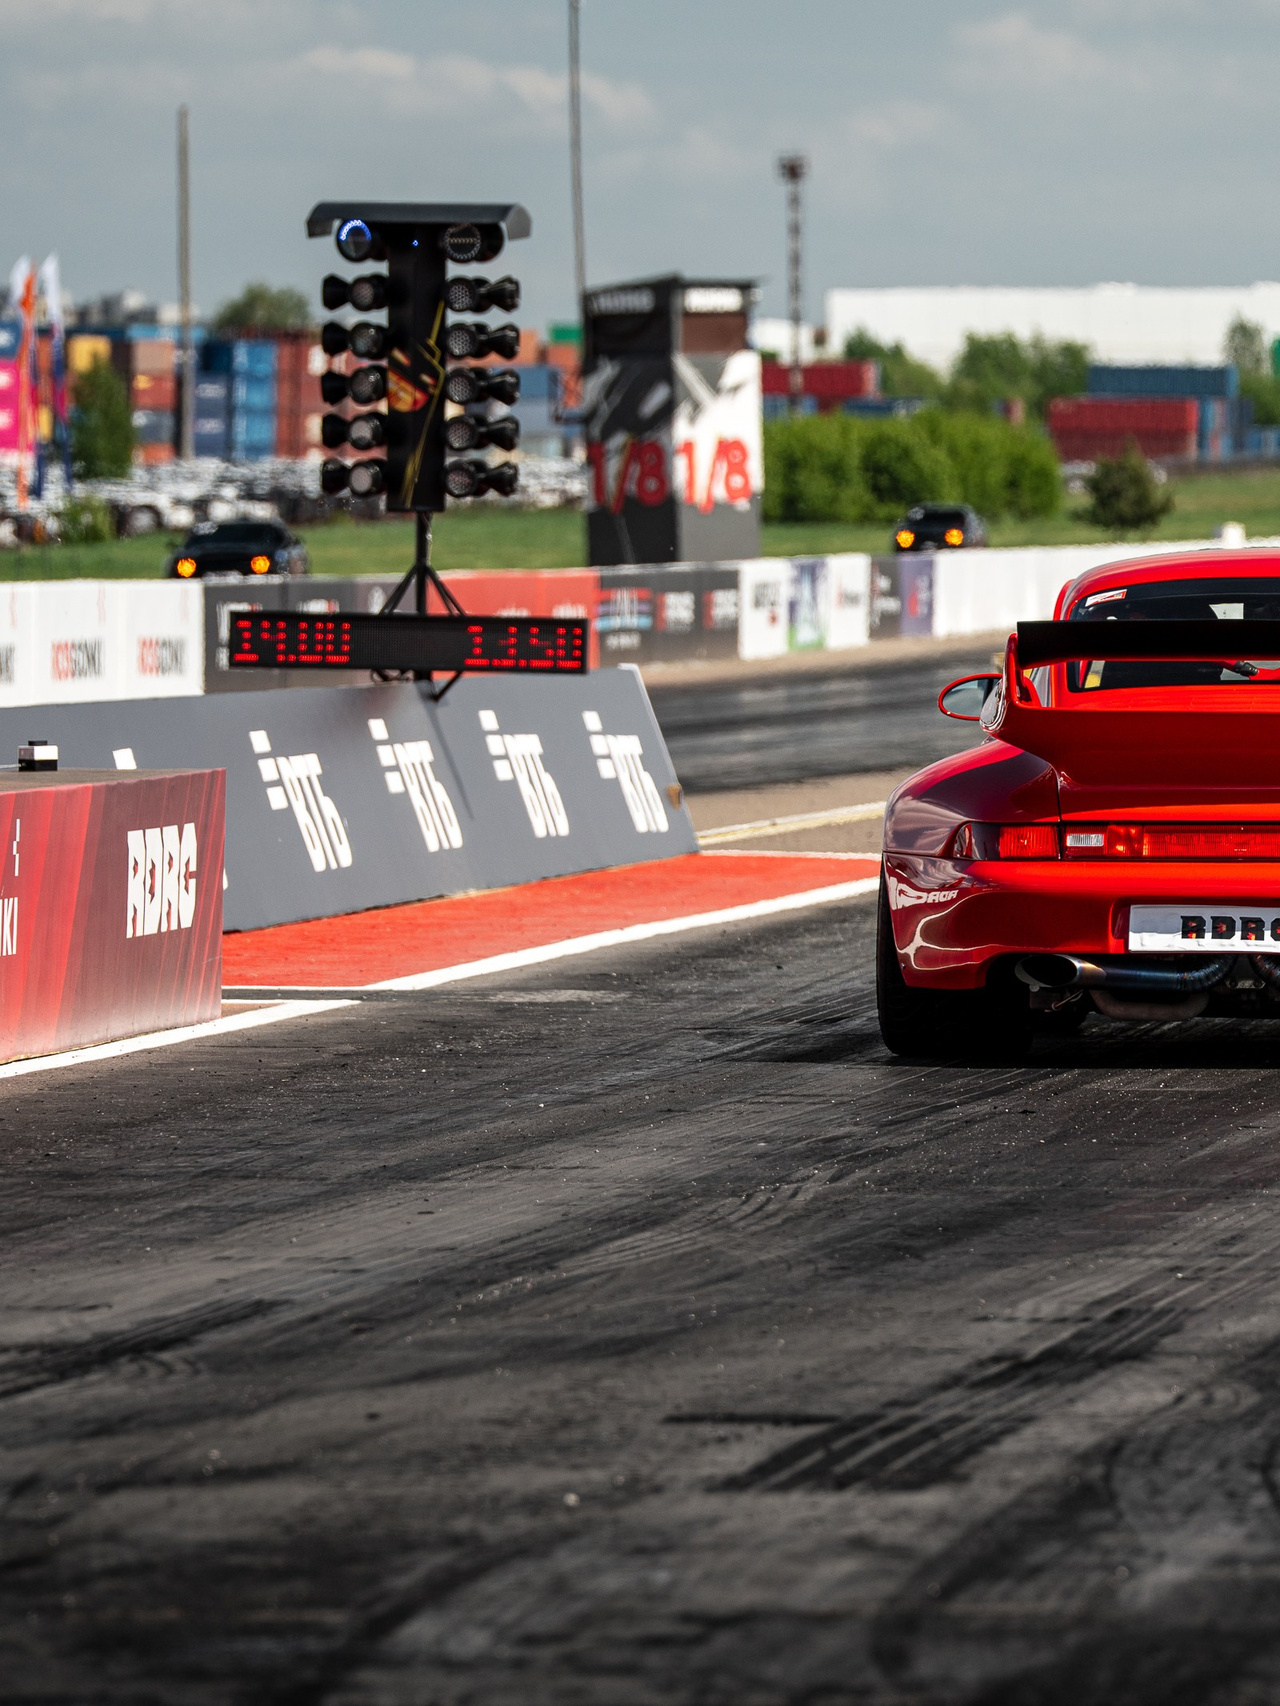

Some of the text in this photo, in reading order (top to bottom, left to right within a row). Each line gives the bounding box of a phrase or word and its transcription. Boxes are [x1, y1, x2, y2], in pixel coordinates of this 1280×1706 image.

[589, 439, 667, 514] 1/8
[675, 437, 752, 513] 1/8
[126, 822, 197, 938] RDRC
[0, 897, 18, 956] KI
